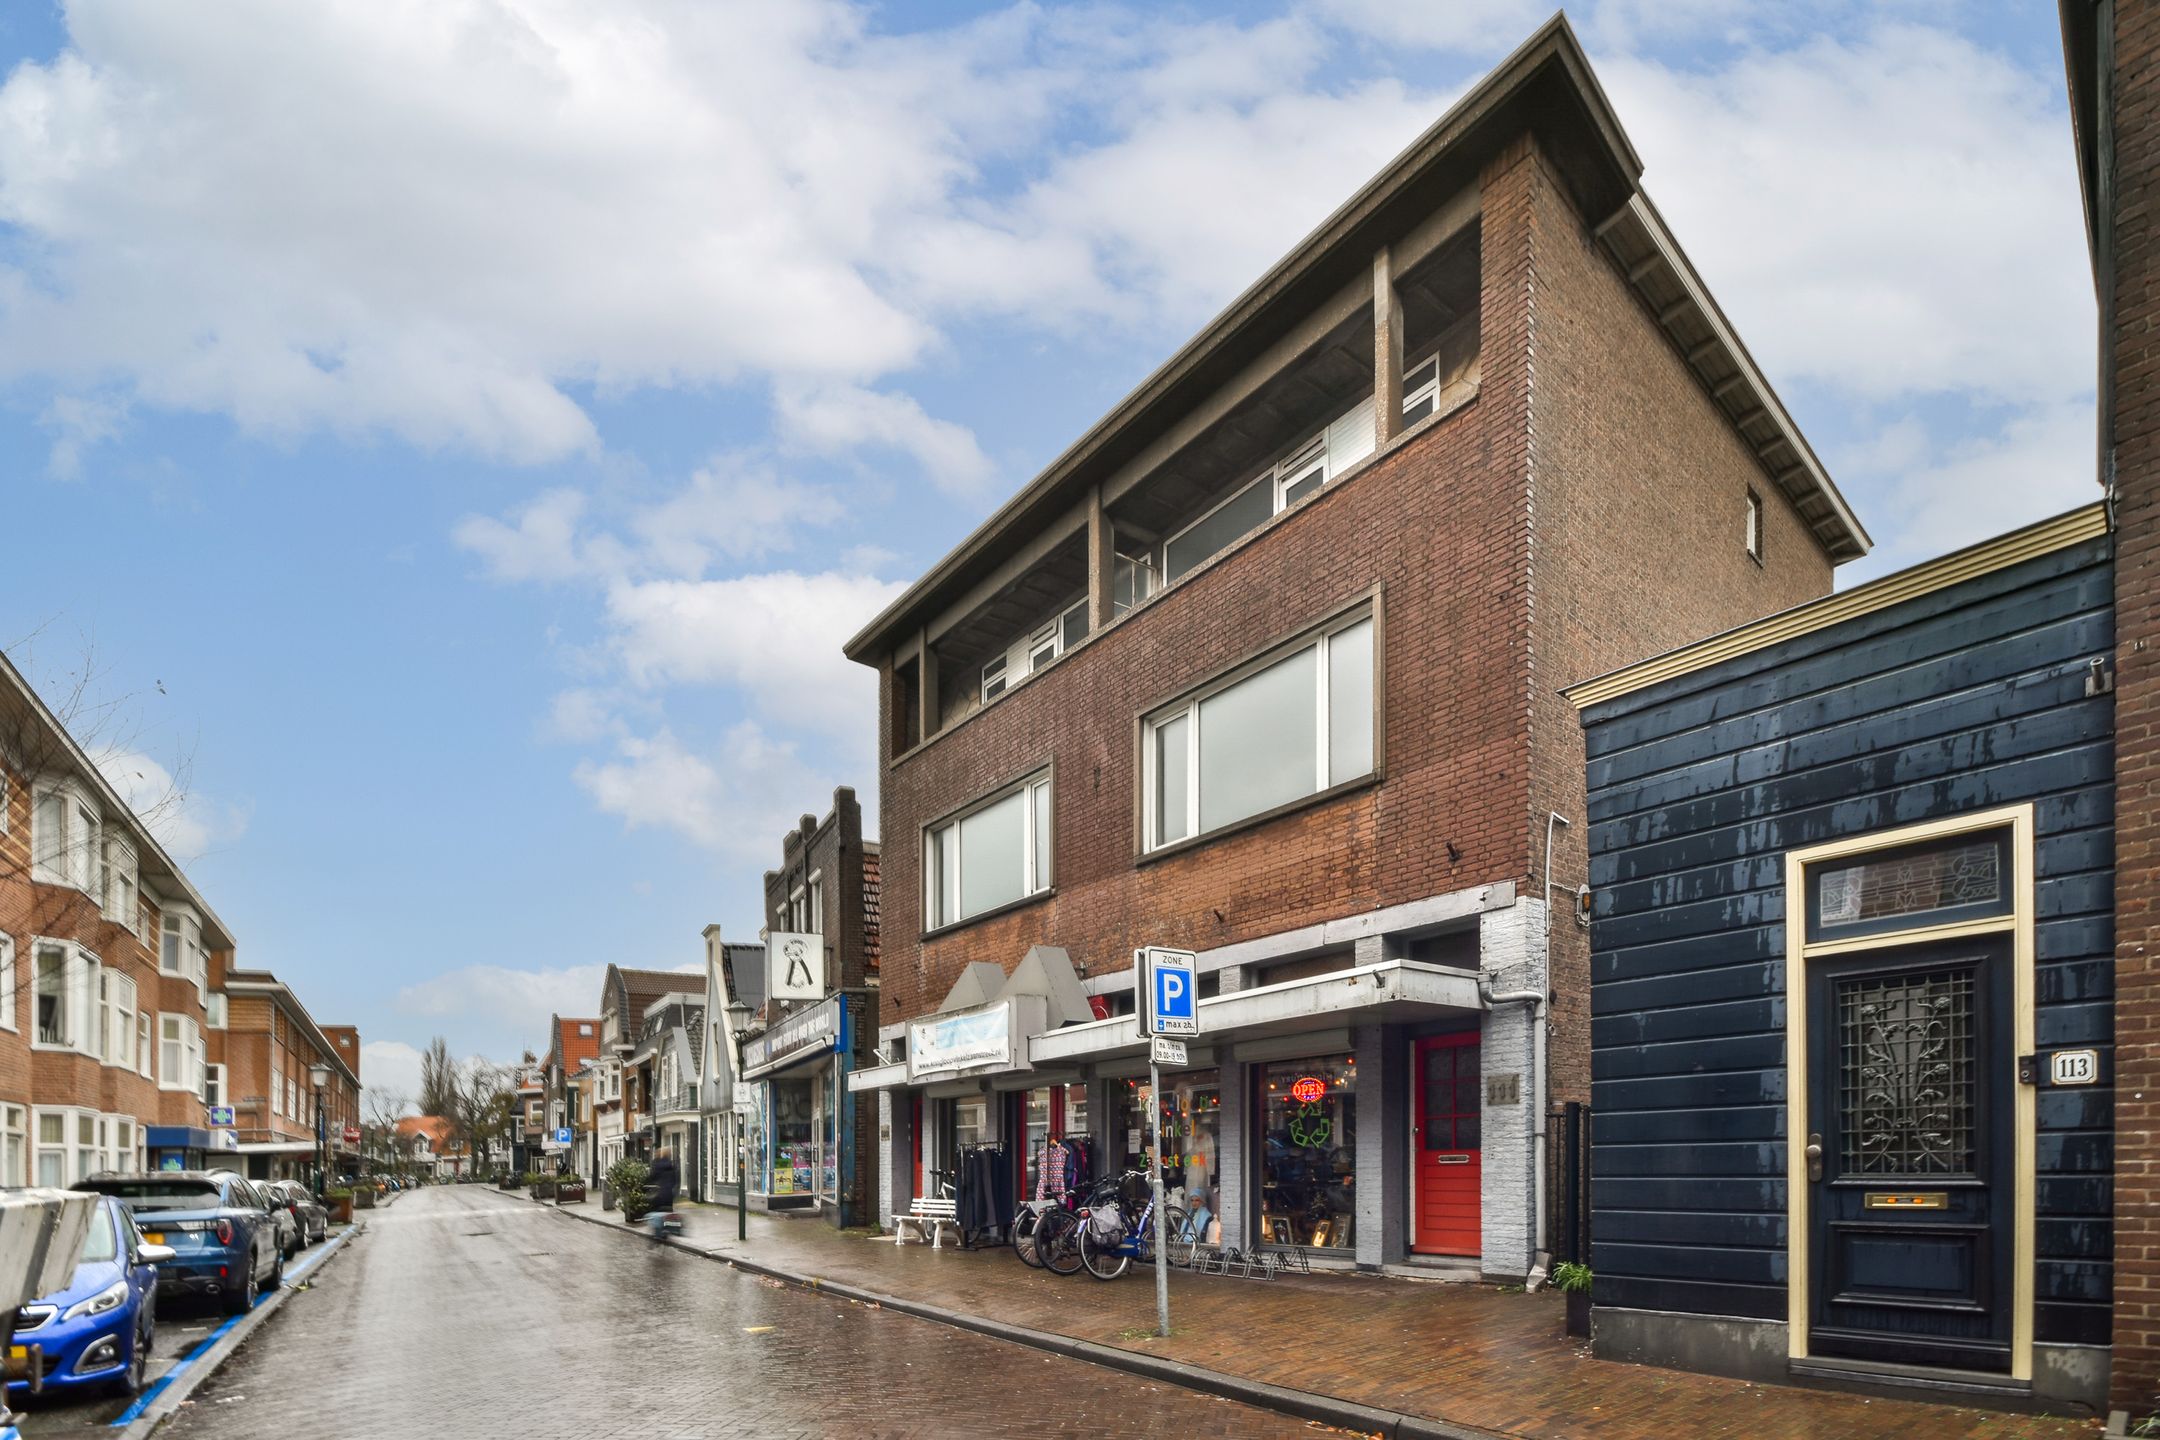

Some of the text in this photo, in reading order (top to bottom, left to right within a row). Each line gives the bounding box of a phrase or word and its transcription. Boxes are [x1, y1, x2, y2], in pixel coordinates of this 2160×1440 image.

[1162, 955, 1183, 966] ZONE
[1163, 973, 1184, 1012] P
[1165, 1020, 1182, 1029] max
[2060, 1058, 2088, 1078] 113
[1292, 1083, 1325, 1097] OPEN
